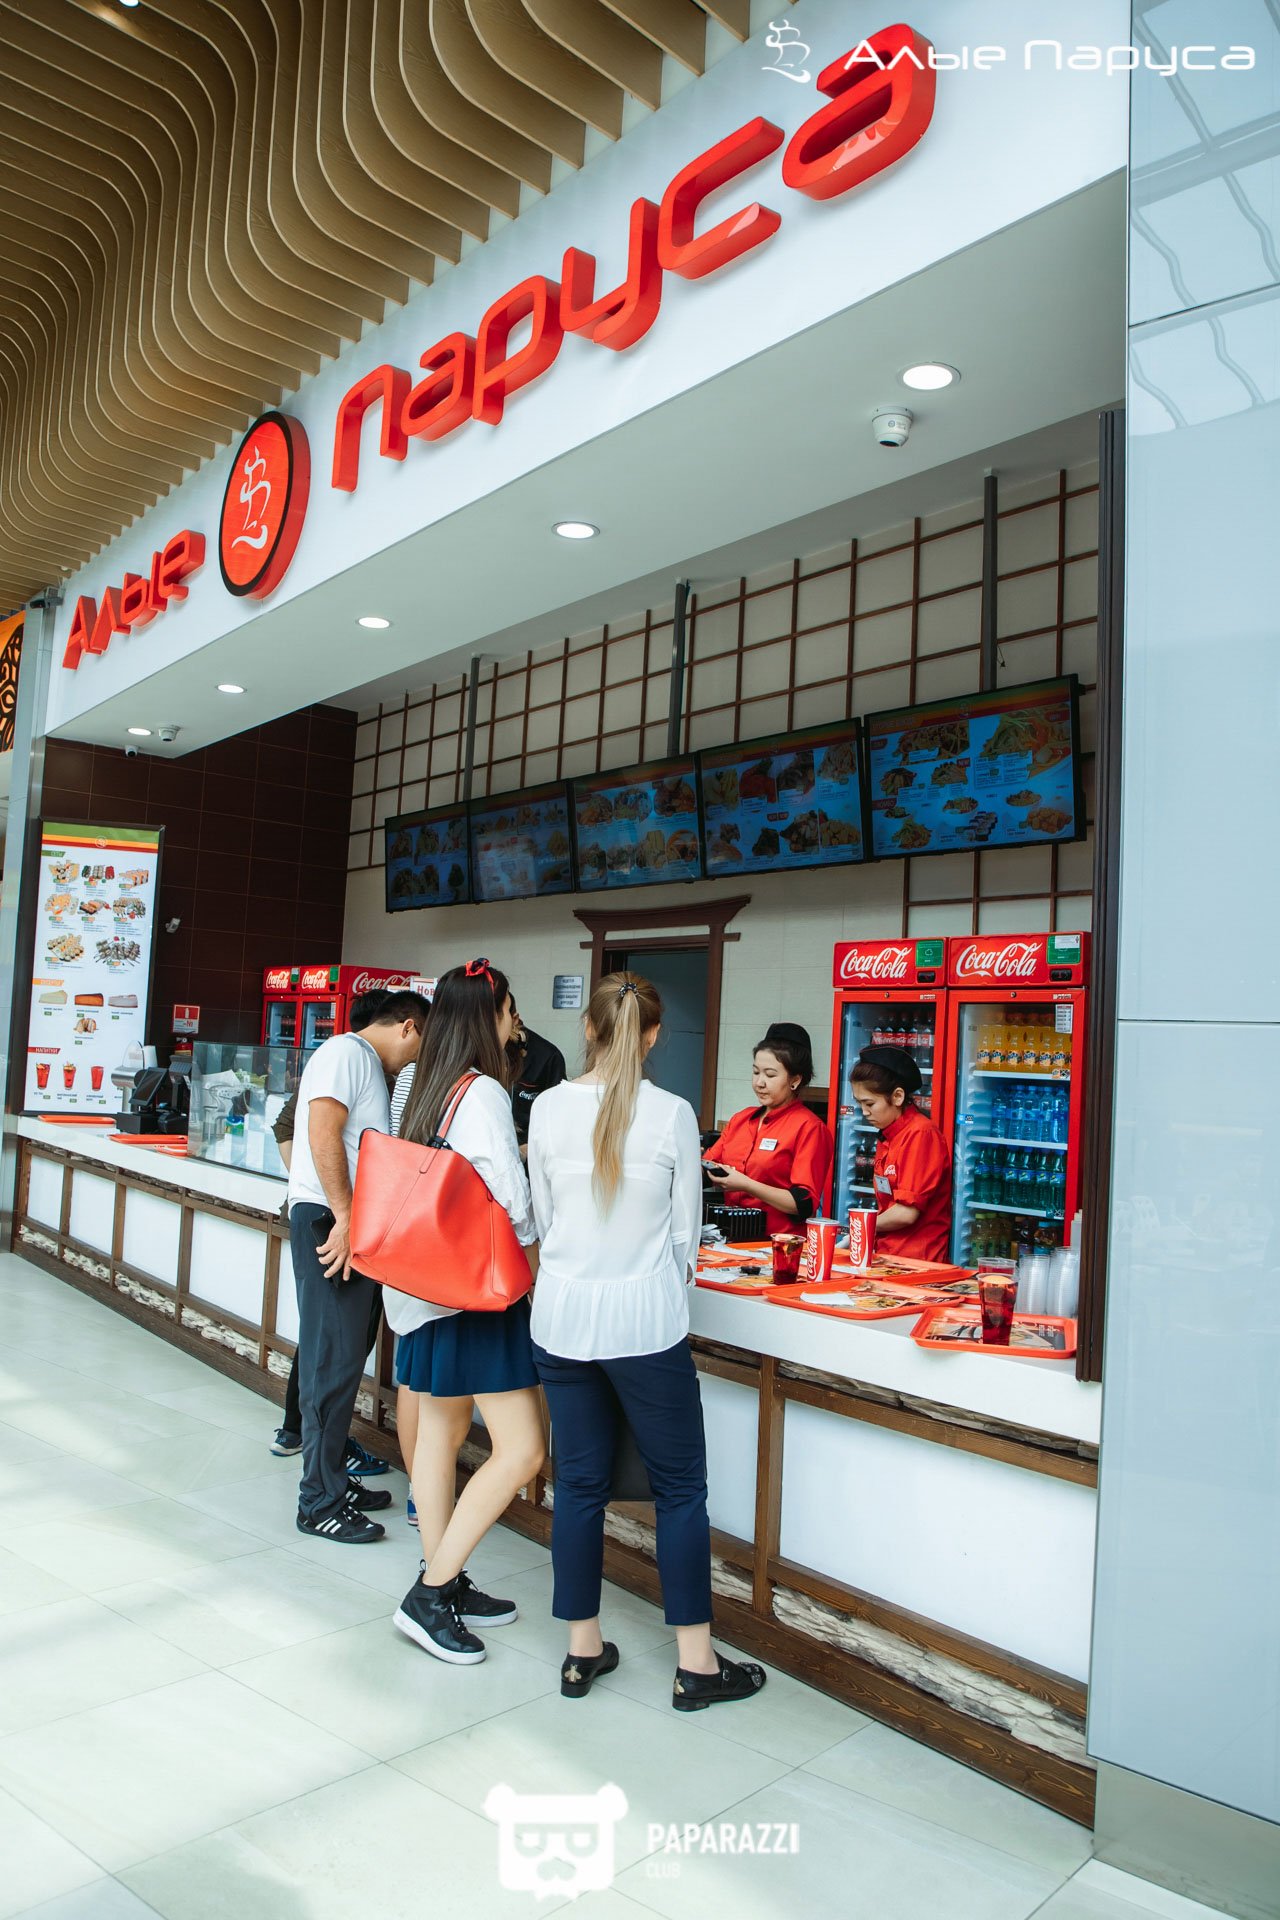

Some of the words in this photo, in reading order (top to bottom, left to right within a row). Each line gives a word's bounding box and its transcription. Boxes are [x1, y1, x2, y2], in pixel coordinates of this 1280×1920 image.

[62, 530, 207, 671] Алые
[840, 947, 913, 979] Coca-Cola
[955, 942, 1043, 978] Coca-Cola
